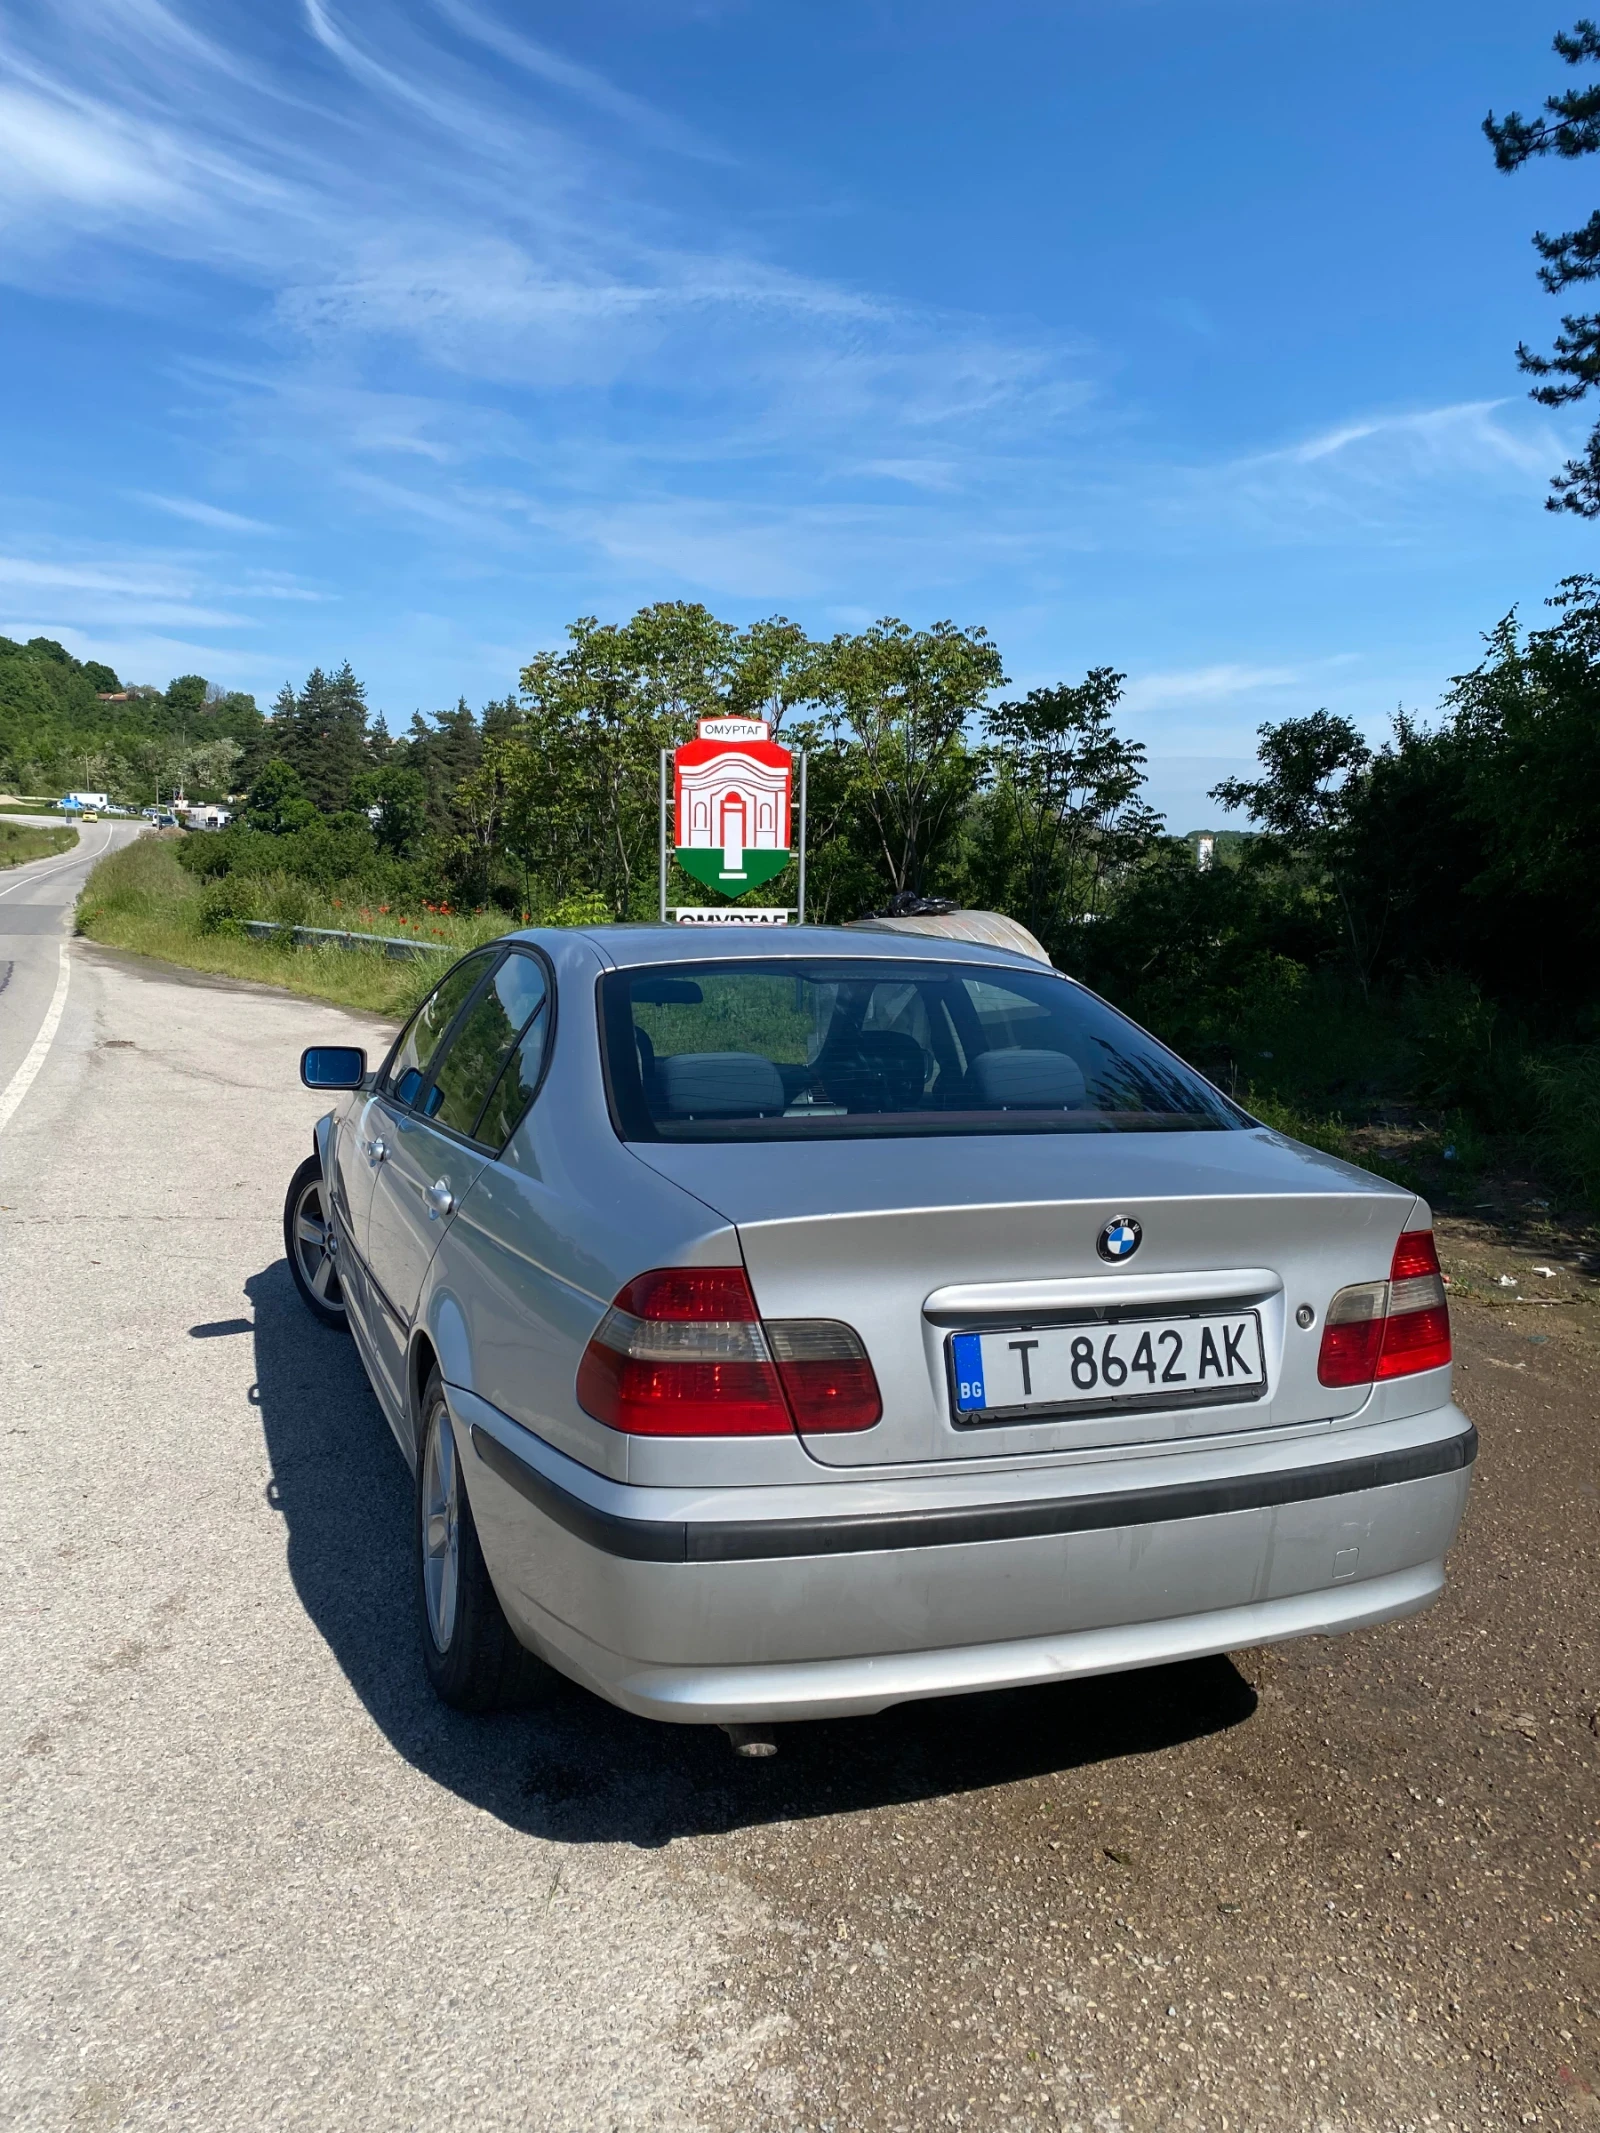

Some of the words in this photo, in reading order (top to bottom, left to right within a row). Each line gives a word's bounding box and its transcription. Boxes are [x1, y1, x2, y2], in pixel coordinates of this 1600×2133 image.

[704, 724, 762, 735] ОМУРТАГ
[1105, 1218, 1141, 1235] BMW
[1008, 1339, 1039, 1395] T
[1070, 1329, 1187, 1390] 8642
[1198, 1323, 1254, 1380] AK
[960, 1381, 982, 1399] BG
